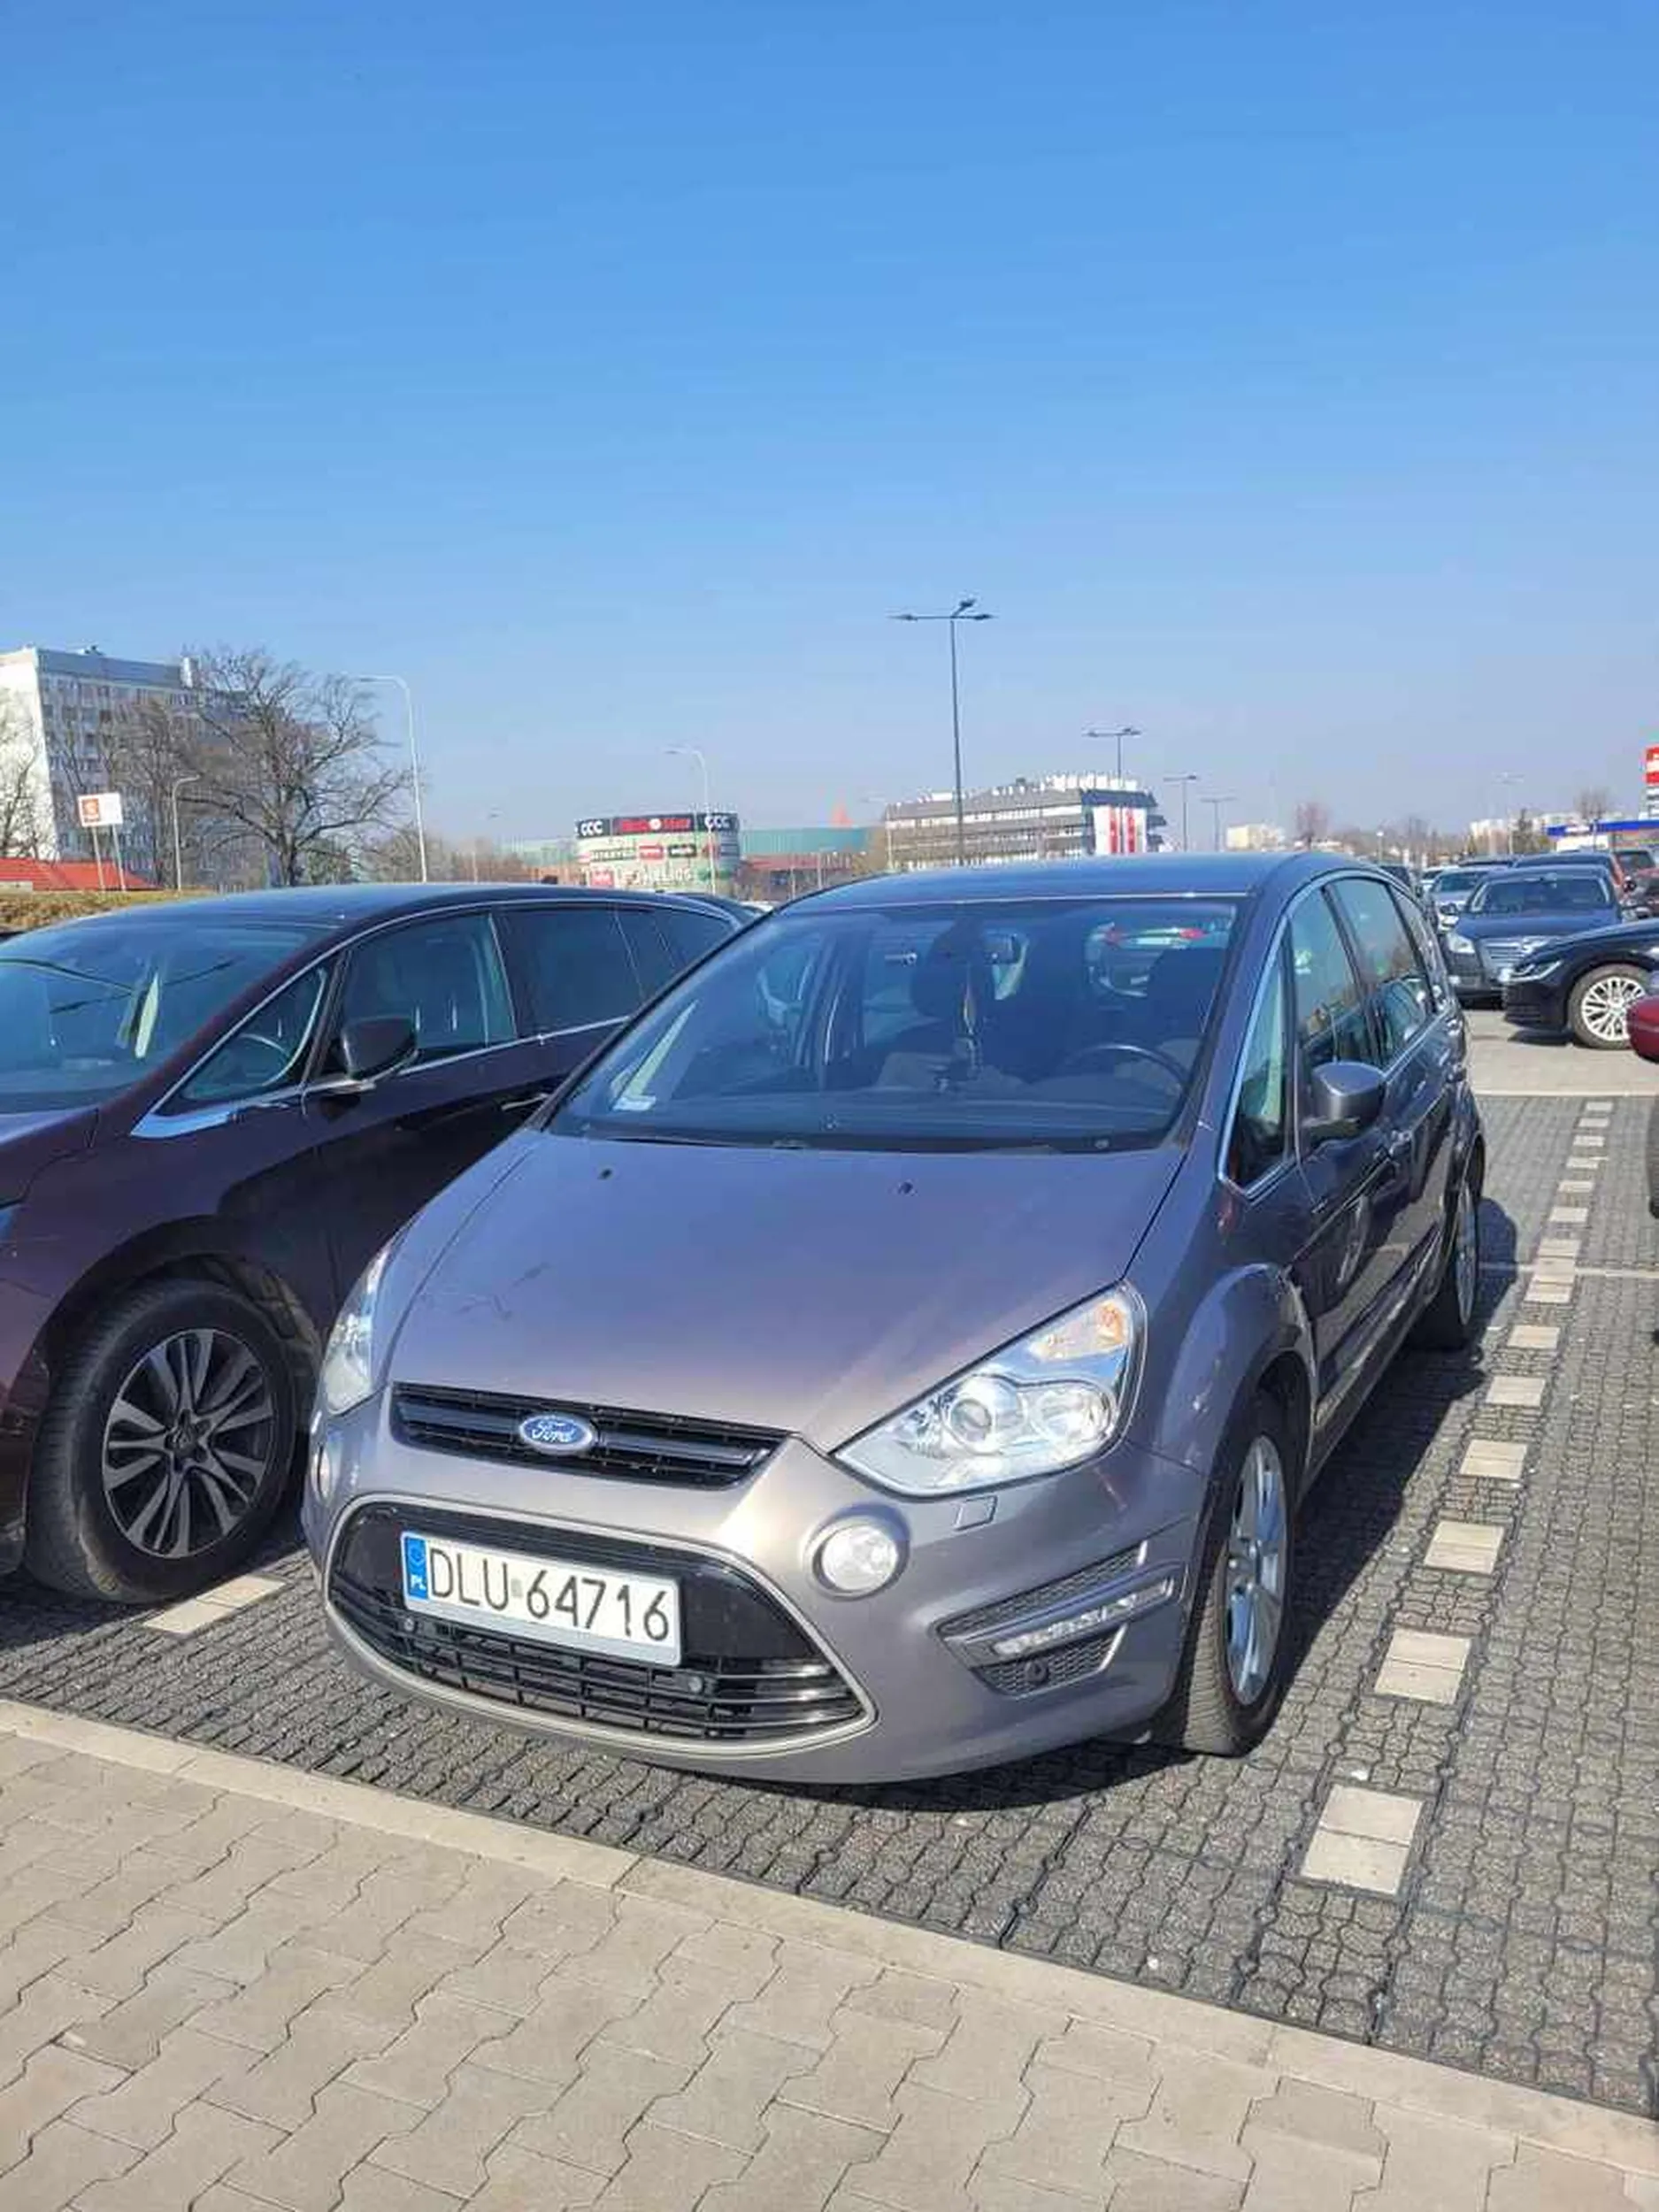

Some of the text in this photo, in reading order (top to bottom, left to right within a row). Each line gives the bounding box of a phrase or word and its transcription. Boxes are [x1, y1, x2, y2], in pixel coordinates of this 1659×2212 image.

[580, 820, 603, 836] CCC
[704, 815, 731, 828] CCC
[531, 1419, 578, 1443] Ford
[410, 1574, 427, 1592] PL
[430, 1548, 669, 1641] DLU 64716
